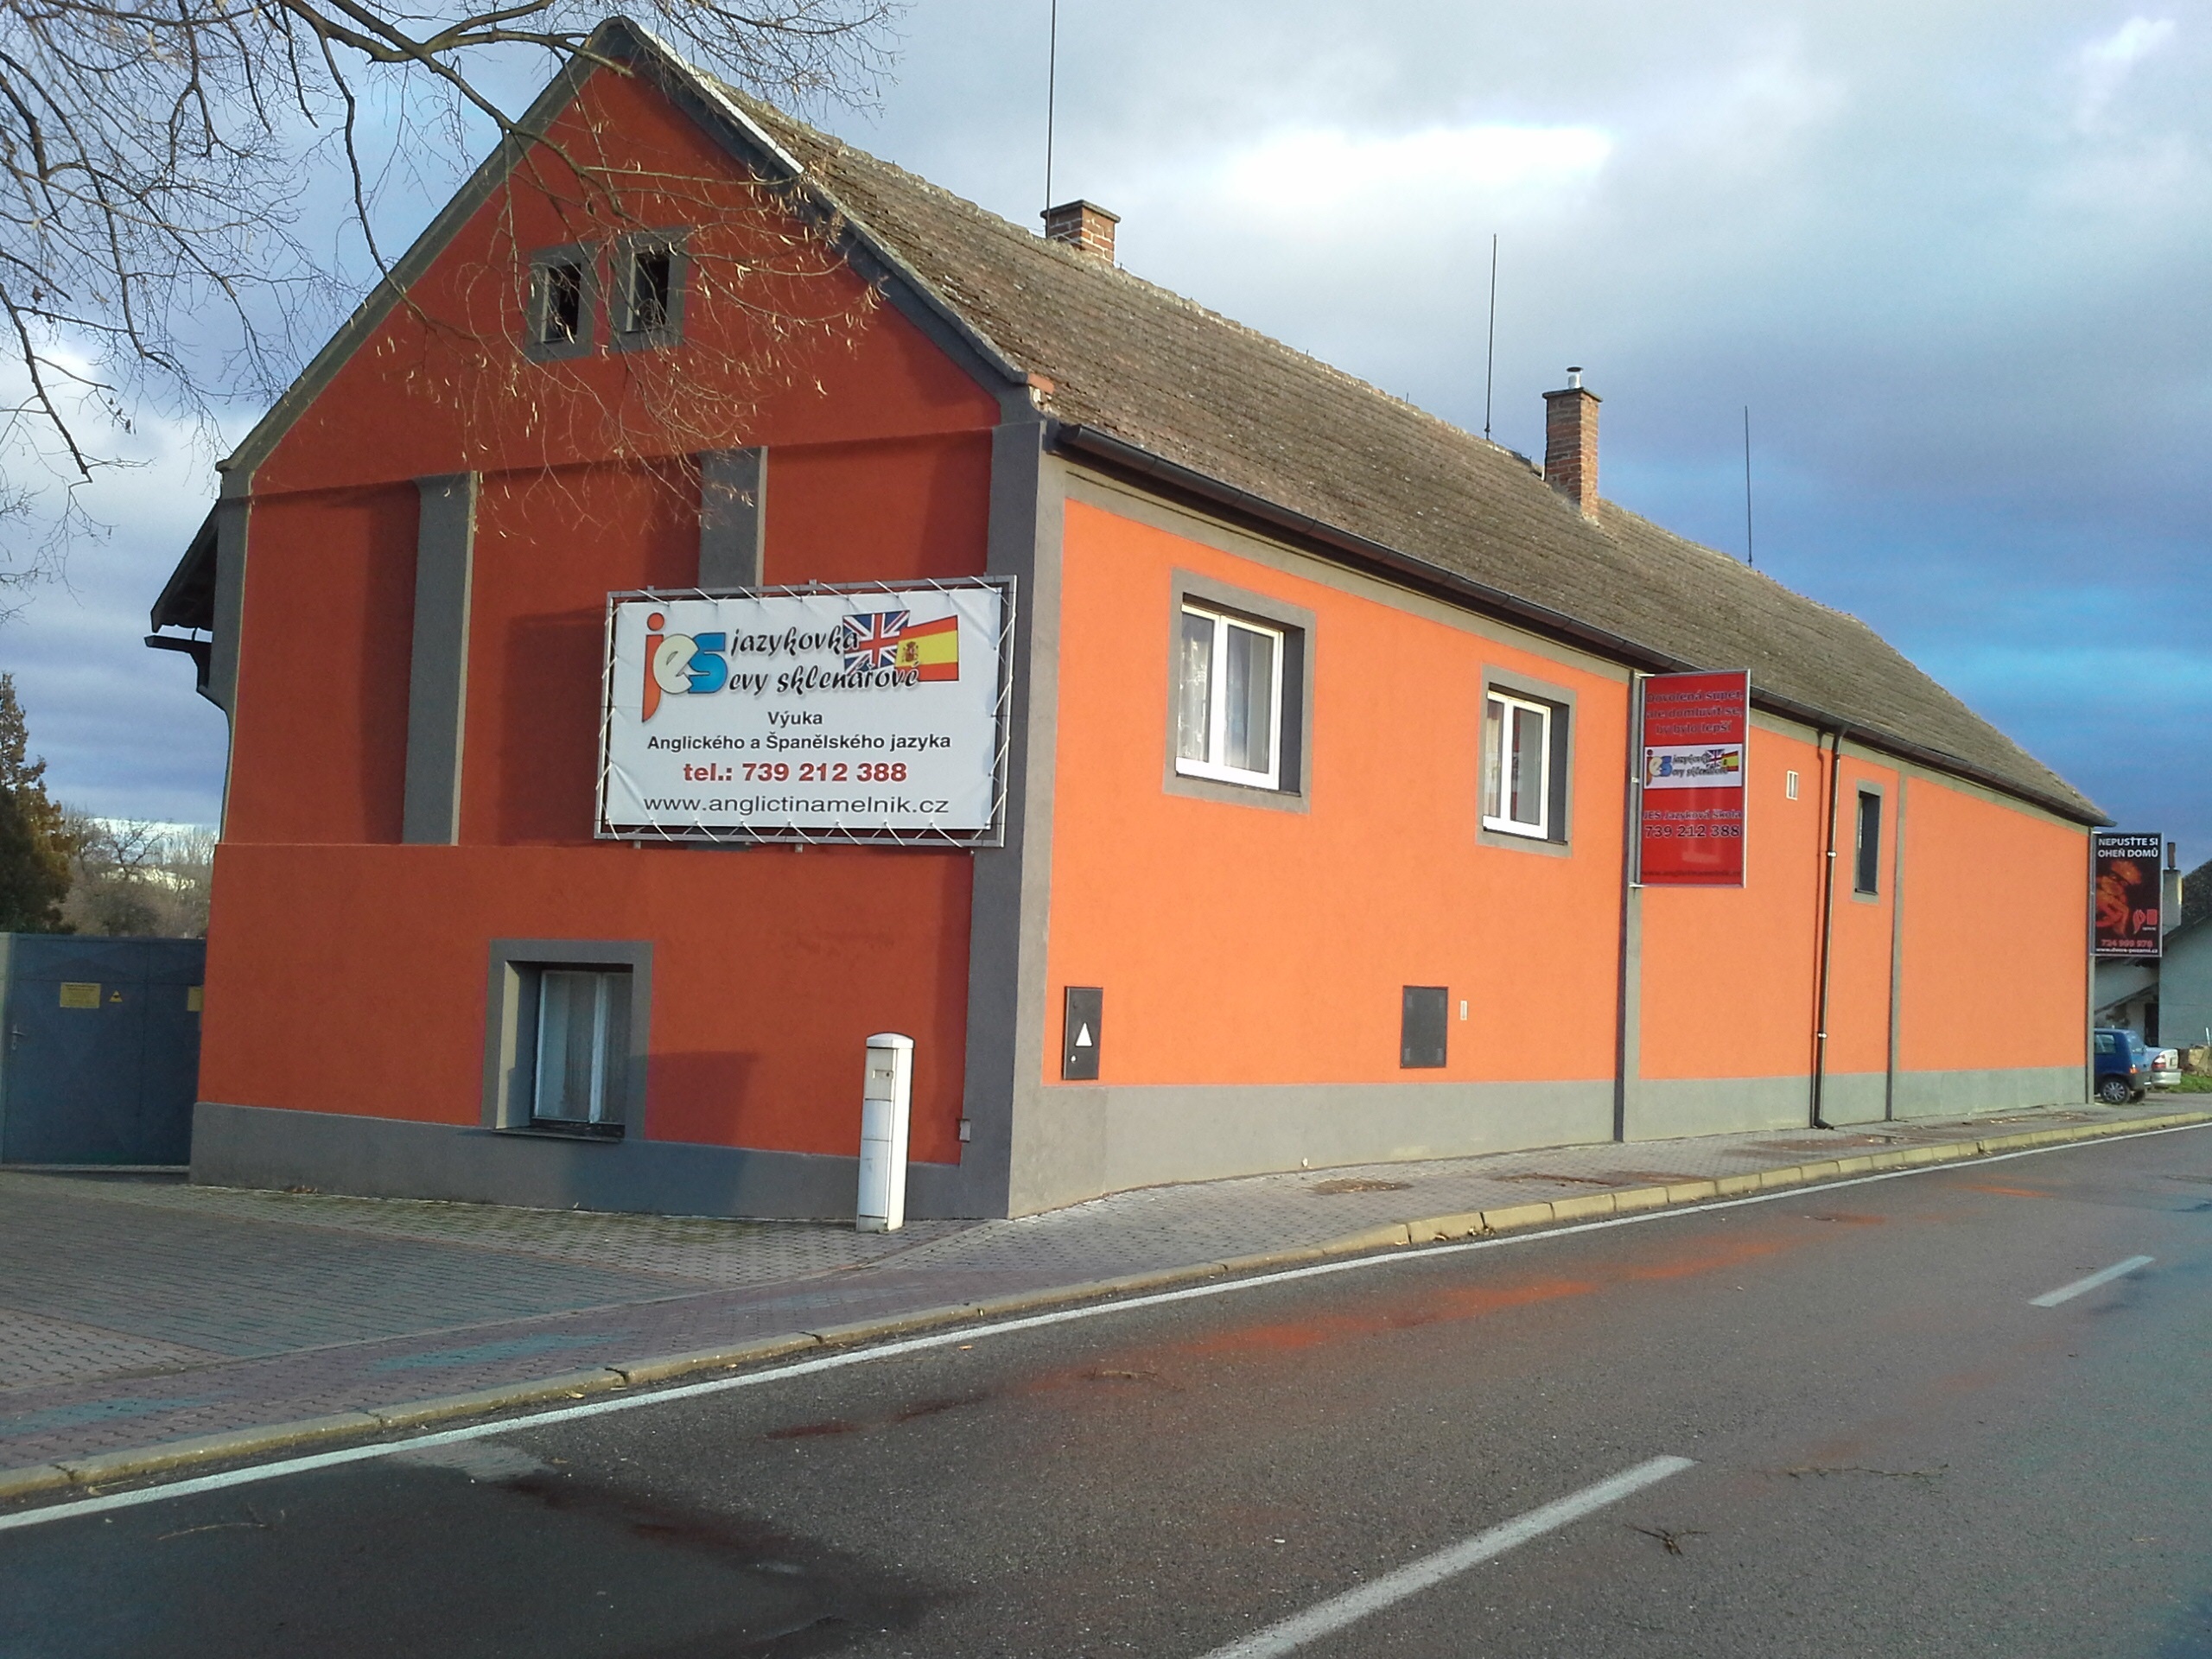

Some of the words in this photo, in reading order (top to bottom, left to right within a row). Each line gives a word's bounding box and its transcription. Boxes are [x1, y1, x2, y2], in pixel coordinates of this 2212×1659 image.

[730, 626, 860, 657] jazykovka
[728, 672, 769, 696] evy
[767, 711, 823, 728] Výuka
[647, 735, 745, 753] Anglického
[750, 738, 760, 749] a
[766, 732, 885, 753] Španělského
[889, 734, 951, 752] jazyka
[683, 762, 733, 781] tel.:
[741, 762, 790, 782] 739
[798, 762, 849, 782] 212
[856, 762, 907, 782] 388
[644, 796, 949, 816] www.anglictinamelnik.cz
[1644, 824, 1673, 837] 739
[1676, 824, 1706, 837] 212
[1710, 823, 1740, 837] 388
[2098, 836, 2147, 846] NEPUSŤTE
[2149, 837, 2158, 846] SI
[2098, 848, 2126, 858] OHEŇ
[2127, 848, 2158, 858] DOMŮ
